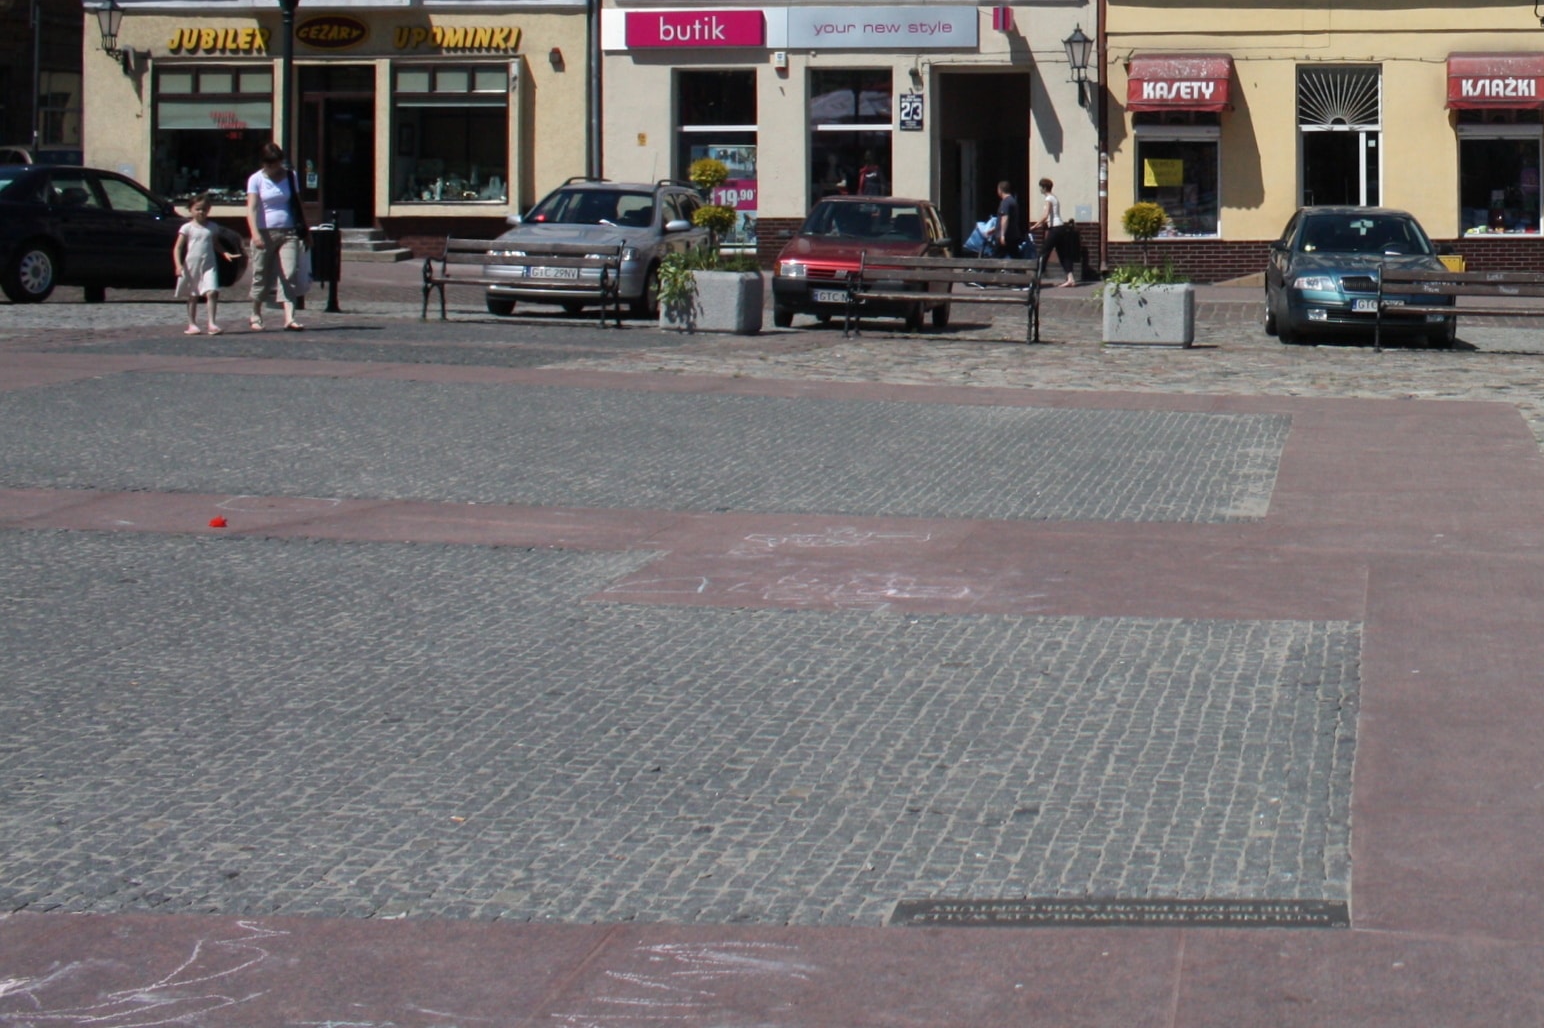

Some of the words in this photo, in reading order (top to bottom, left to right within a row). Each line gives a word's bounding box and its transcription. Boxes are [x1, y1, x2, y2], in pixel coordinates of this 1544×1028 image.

[394, 25, 521, 49] UPOMINKI
[659, 16, 726, 41] butik
[813, 22, 856, 36] your
[863, 22, 902, 34] new
[907, 21, 953, 35] style
[167, 27, 270, 51] JUBILER
[1142, 81, 1215, 100] KASETY
[1461, 76, 1536, 98] KSIĄŻKI
[901, 102, 923, 121] 2/3
[819, 291, 840, 302] GTC
